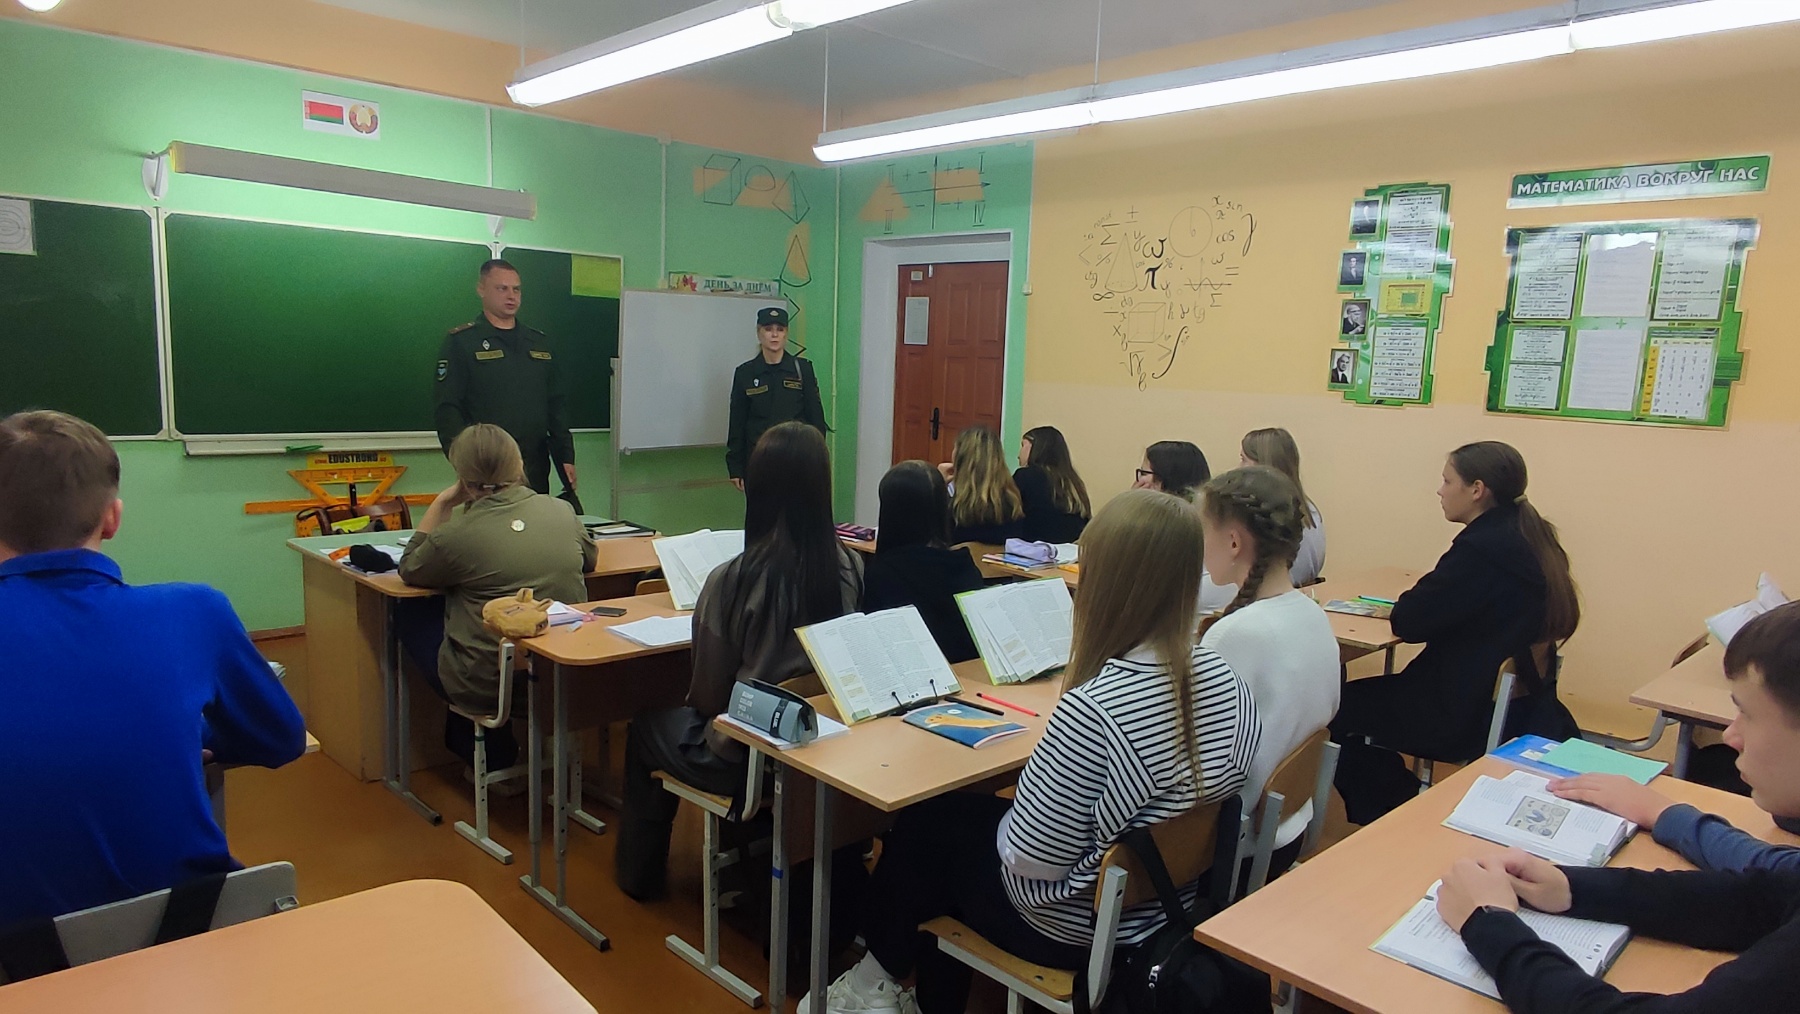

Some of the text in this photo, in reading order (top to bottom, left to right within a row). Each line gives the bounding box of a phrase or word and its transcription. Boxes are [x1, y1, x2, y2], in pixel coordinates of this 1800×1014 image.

[1516, 166, 1760, 196] МАТЕМАТИКА ВОКРУГ НАС
[1226, 201, 1243, 212] sin
[1216, 229, 1235, 244] cos
[703, 279, 730, 289] ДЕНЬ
[733, 281, 744, 291] ЗА
